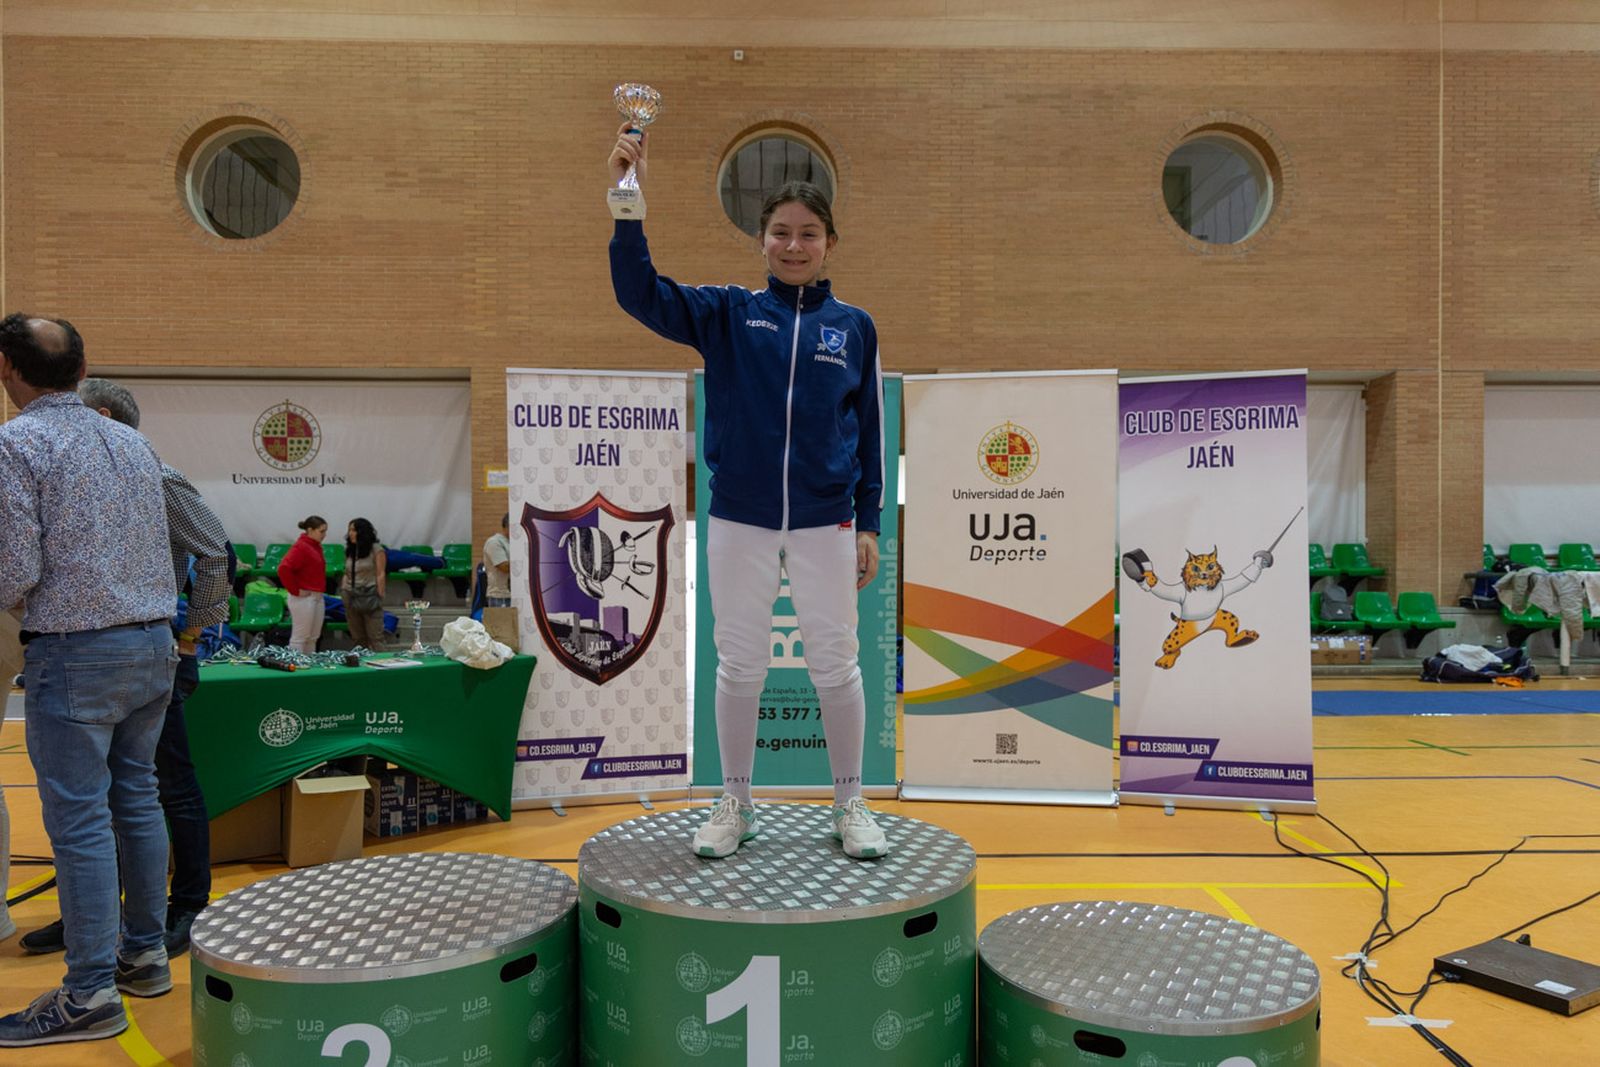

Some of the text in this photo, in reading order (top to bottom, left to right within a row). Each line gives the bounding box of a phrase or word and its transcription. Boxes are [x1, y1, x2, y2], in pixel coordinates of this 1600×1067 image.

[514, 404, 679, 430] CLUB DE ESGRIMA
[1125, 405, 1299, 435] CLUB DE ESGRIMA
[575, 439, 620, 466] JAÉN
[1187, 441, 1234, 468] JAÉN
[232, 473, 346, 487] UNIVERSIDAD DE JAÉN
[952, 488, 1064, 500] Universidad de Jaén
[970, 545, 1047, 565] Deporte
[305, 713, 355, 725] Universidad
[758, 707, 777, 720] 53
[782, 707, 810, 720] 577
[318, 722, 338, 730] Jaén
[365, 725, 403, 735] Deporte
[755, 734, 827, 751] e.genuin
[706, 955, 780, 1067] 1
